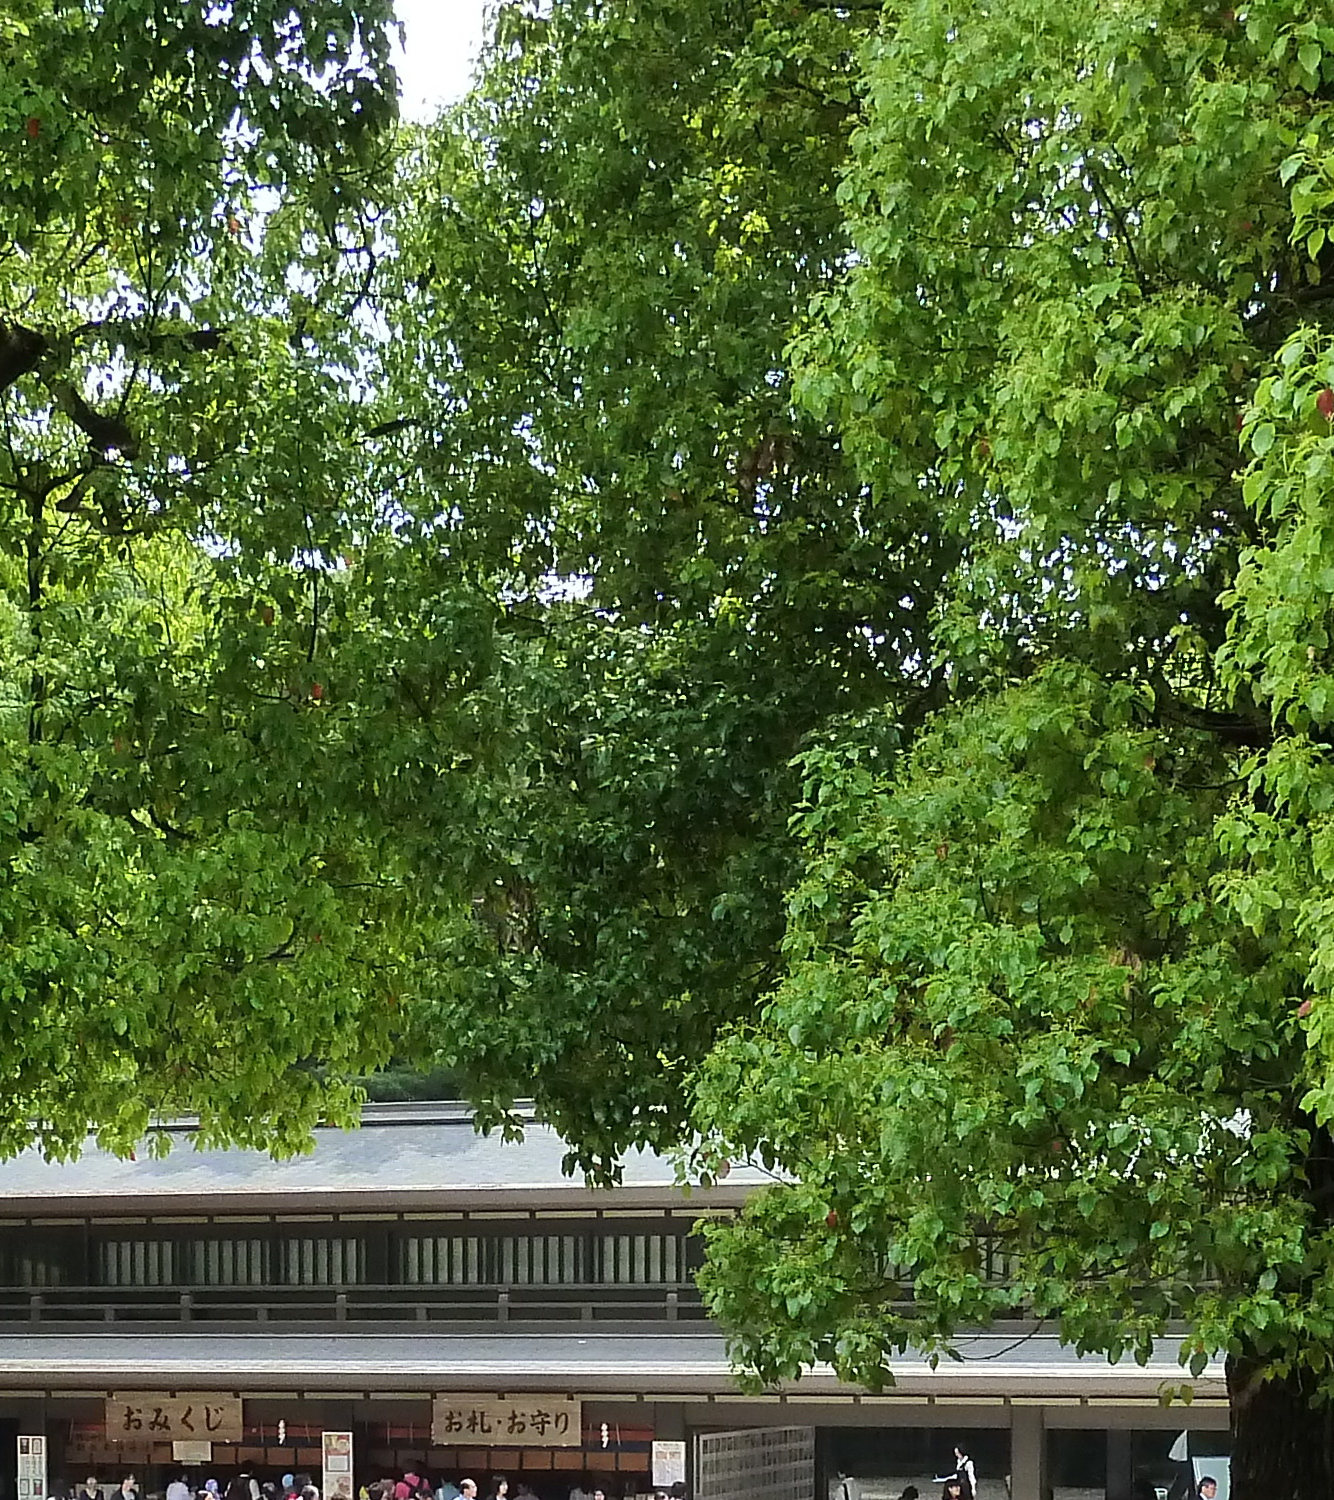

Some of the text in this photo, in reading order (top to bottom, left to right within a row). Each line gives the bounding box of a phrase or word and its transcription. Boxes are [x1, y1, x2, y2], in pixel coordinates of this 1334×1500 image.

[123, 1405, 224, 1432] おみくじ
[445, 1409, 569, 1436] お札・お守り
